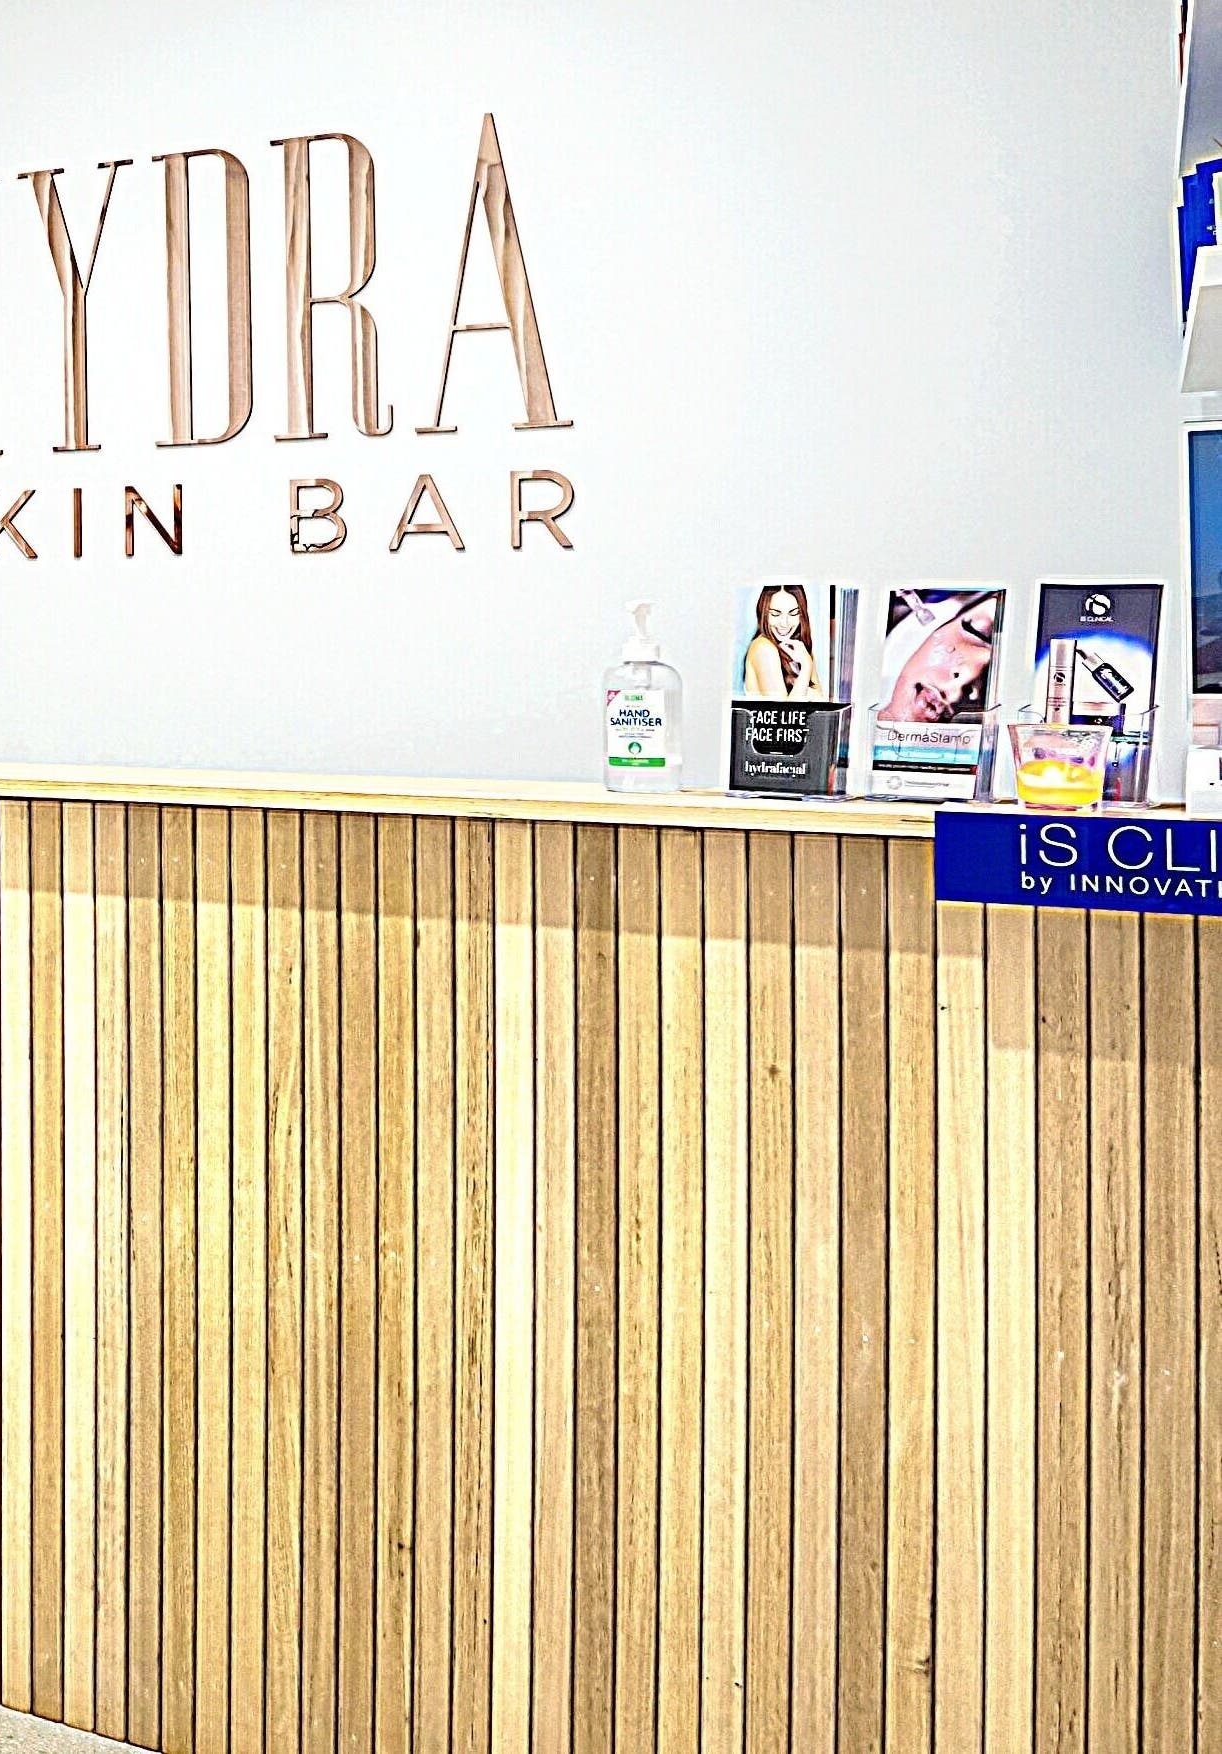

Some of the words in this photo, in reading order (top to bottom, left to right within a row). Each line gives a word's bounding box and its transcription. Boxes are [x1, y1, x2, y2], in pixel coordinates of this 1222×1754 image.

[289, 469, 576, 556] BAR
[619, 709, 650, 718] HAND
[749, 710, 778, 725] FACE
[781, 711, 807, 726] LIFE
[610, 717, 662, 727] SANITISER
[745, 727, 773, 742] FACE
[777, 728, 809, 743] FIRST
[887, 729, 971, 745] DermaStamp
[1019, 823, 1078, 868] iS
[1021, 871, 1053, 895] by
